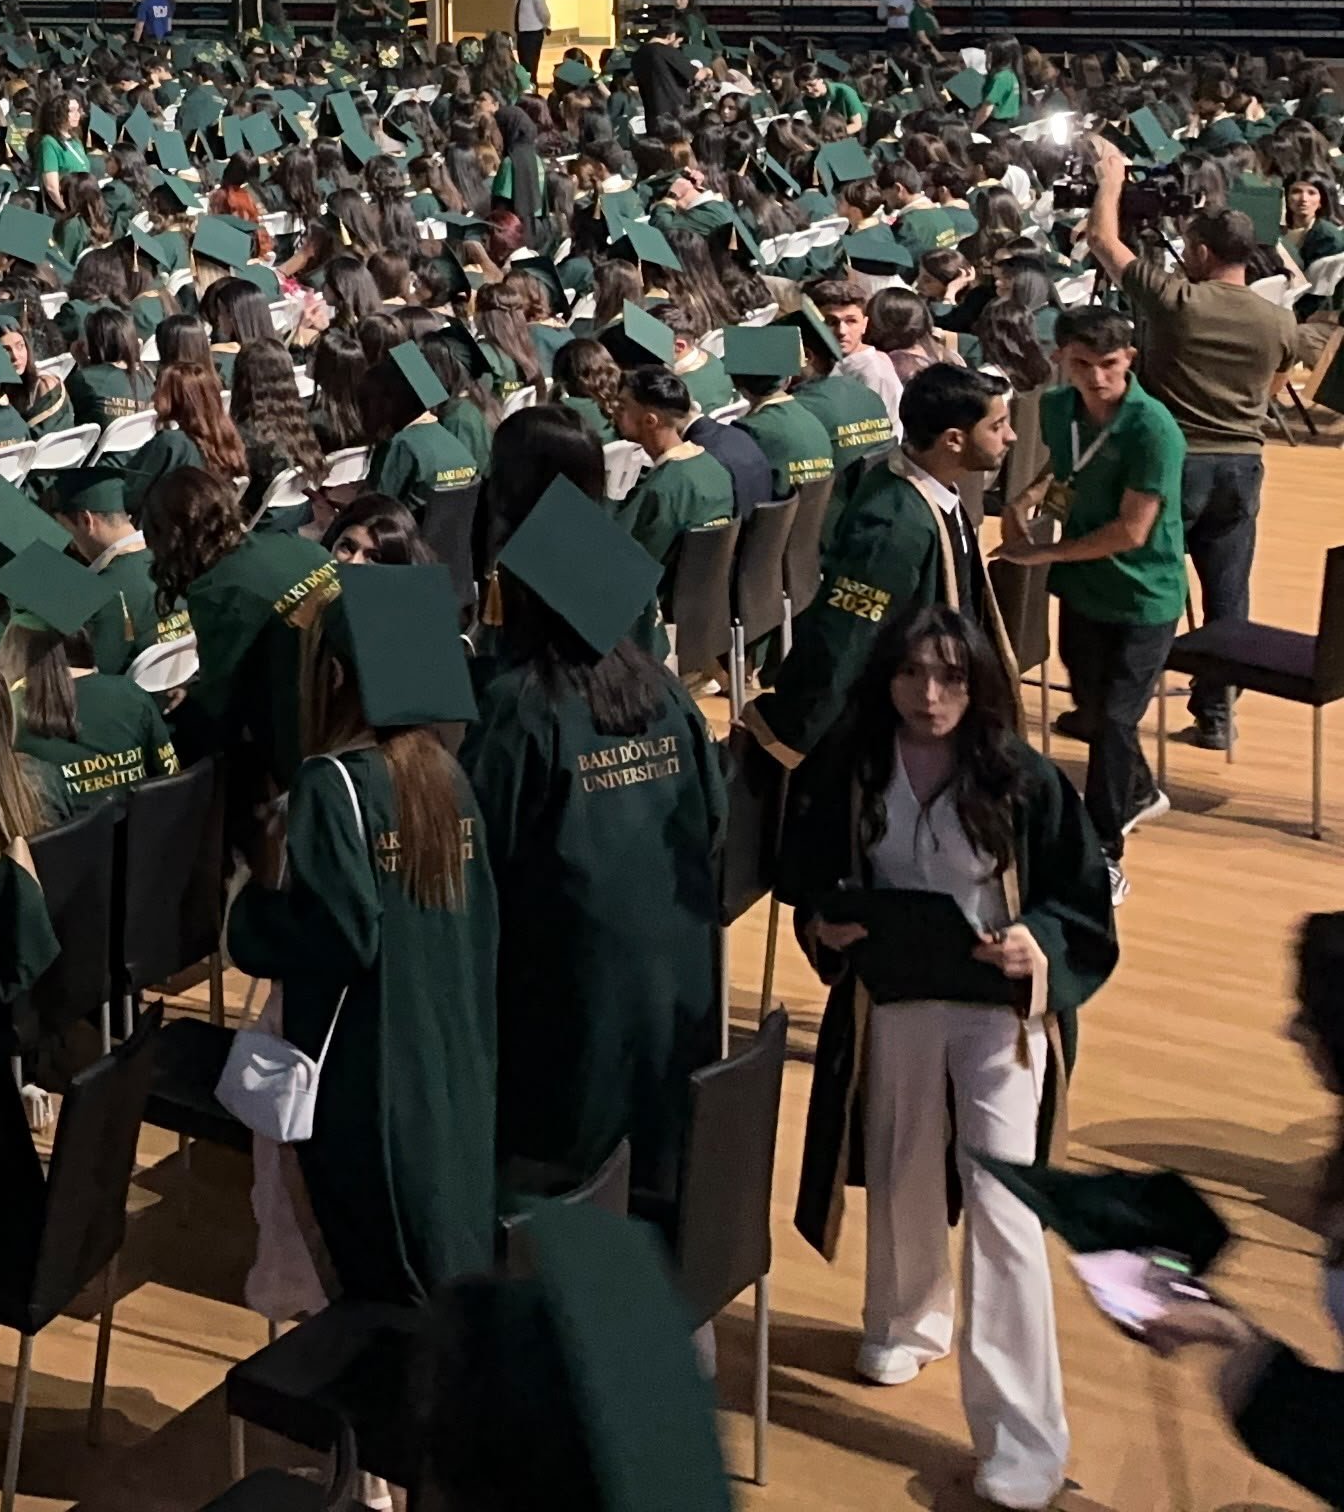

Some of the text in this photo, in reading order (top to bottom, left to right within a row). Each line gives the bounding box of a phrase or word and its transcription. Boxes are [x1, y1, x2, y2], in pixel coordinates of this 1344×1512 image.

[273, 582, 309, 614] BAKI
[827, 587, 884, 623] 2026
[61, 761, 81, 779] KI
[82, 746, 142, 773] DÖVLƏT
[577, 734, 680, 772] BAKI DÖVLƏT
